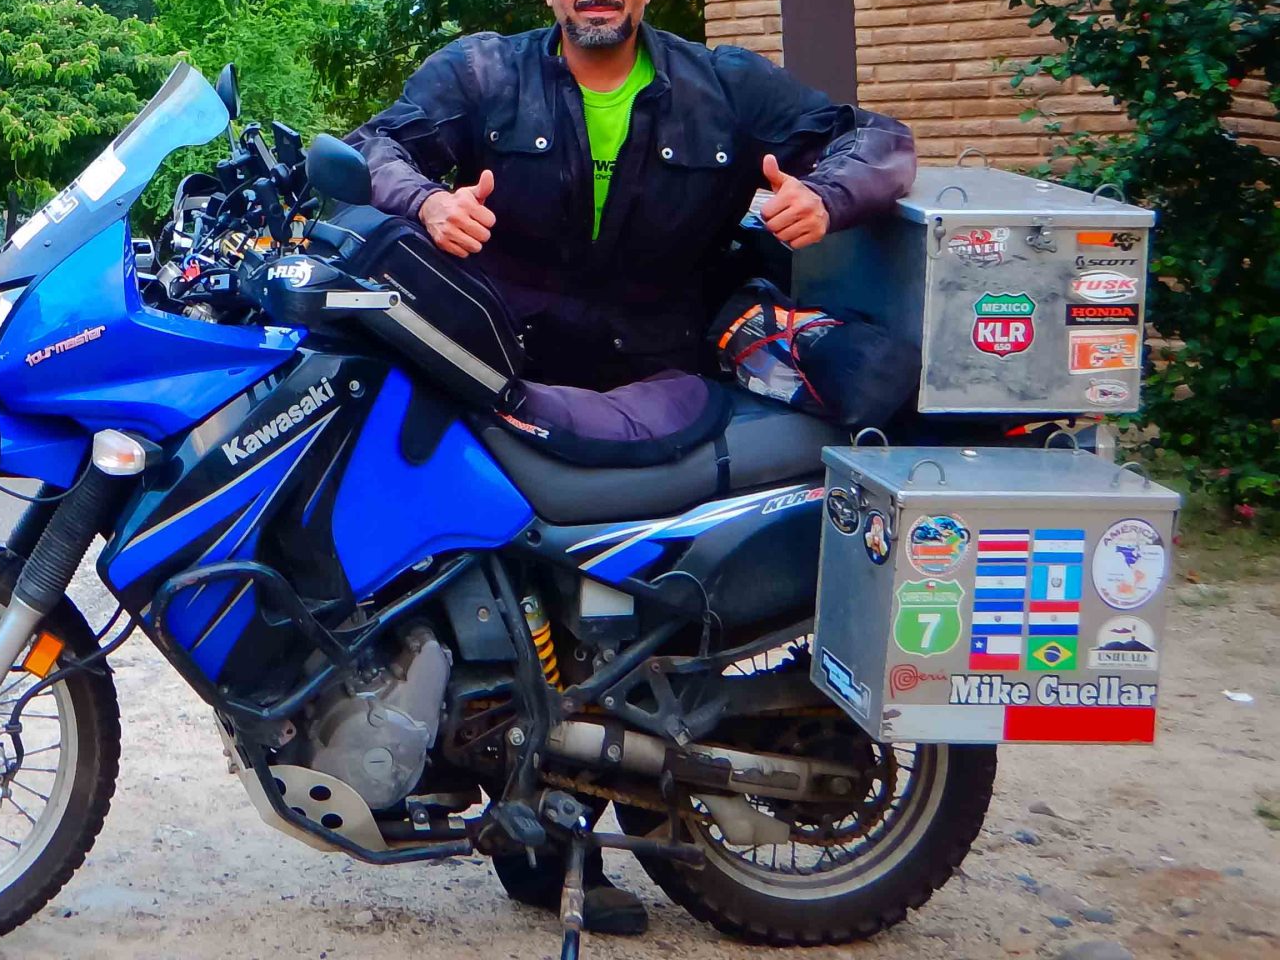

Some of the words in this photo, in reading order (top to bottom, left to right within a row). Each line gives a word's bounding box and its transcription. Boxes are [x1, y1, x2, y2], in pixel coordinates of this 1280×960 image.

[1087, 258, 1138, 267] SCOTT
[1072, 279, 1136, 291] TUSK
[981, 303, 1030, 313] MEXICO
[1071, 306, 1136, 318] HONDA
[977, 322, 1026, 343] KLR
[221, 376, 336, 466] Kawasaki
[918, 613, 941, 648] 7
[949, 674, 1030, 705] Mike
[1036, 674, 1157, 707] Cuellar
